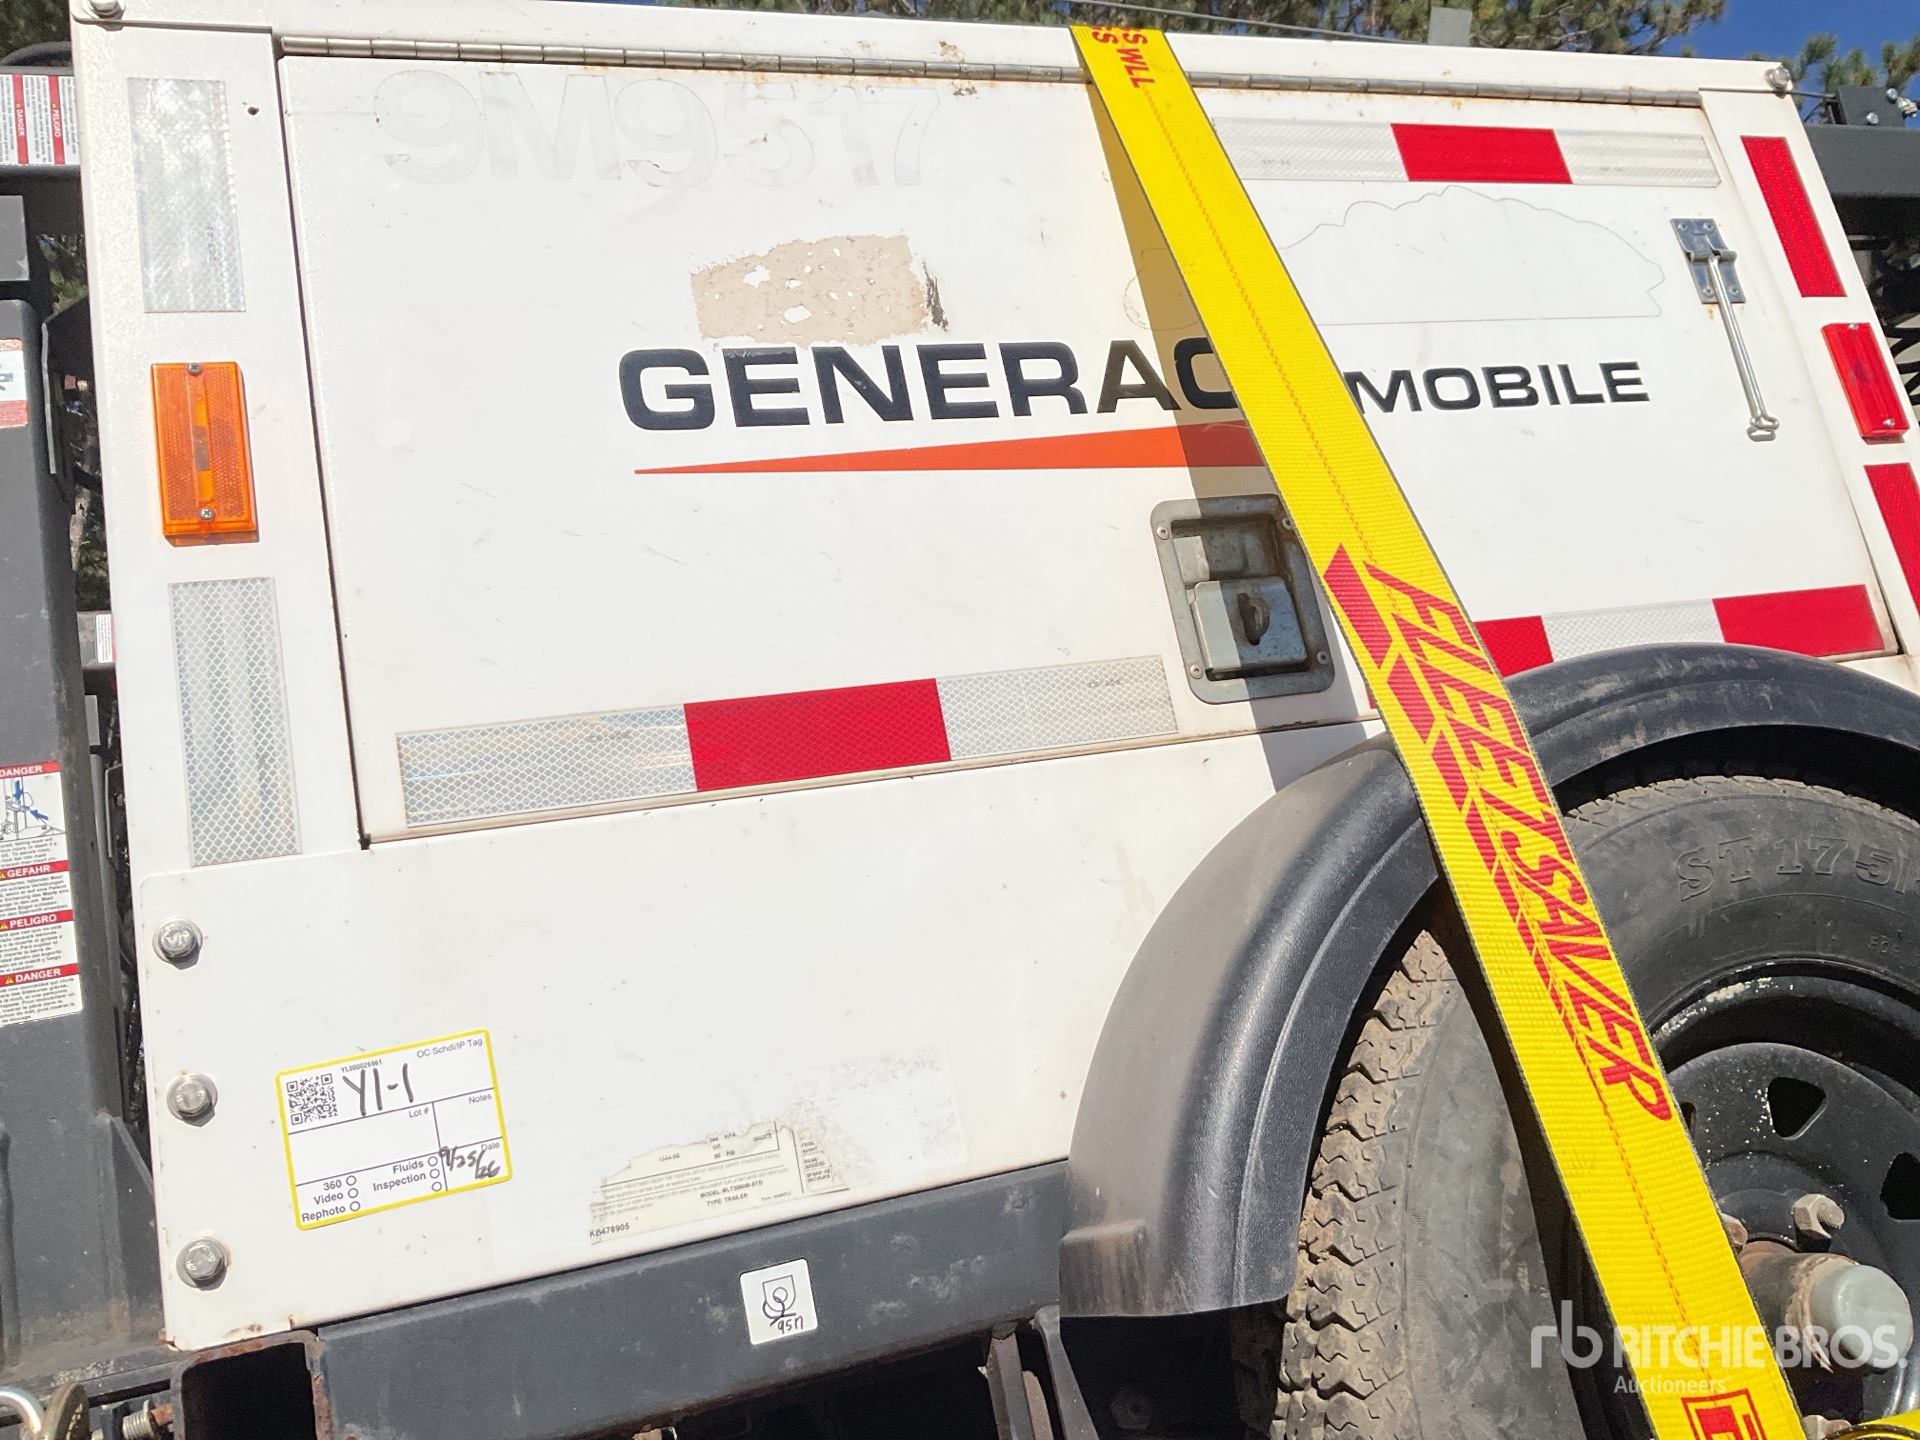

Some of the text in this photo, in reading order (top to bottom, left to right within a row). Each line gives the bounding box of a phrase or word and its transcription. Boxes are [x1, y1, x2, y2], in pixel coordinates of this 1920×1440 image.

[1116, 48, 1156, 88] WLL
[618, 337, 1239, 431] GENERAC
[1342, 361, 1650, 414] MOBILE
[0, 765, 43, 776] DANGER
[7, 864, 51, 878] GEFAHR
[1773, 836, 1920, 894] 175/
[10, 914, 57, 929] PELIGRO
[16, 968, 61, 982] DANGER
[416, 1049, 431, 1058] OC
[467, 1038, 483, 1048] Tag
[468, 1092, 492, 1104] Notes
[409, 1108, 422, 1118] Lot
[481, 1142, 500, 1152] Date
[392, 1160, 424, 1174] Fluids
[324, 1179, 342, 1191] 360
[373, 1172, 426, 1192] Inspection
[314, 1190, 344, 1205] Video
[301, 1205, 346, 1222] Rephoto
[589, 1222, 630, 1238] KB478905
